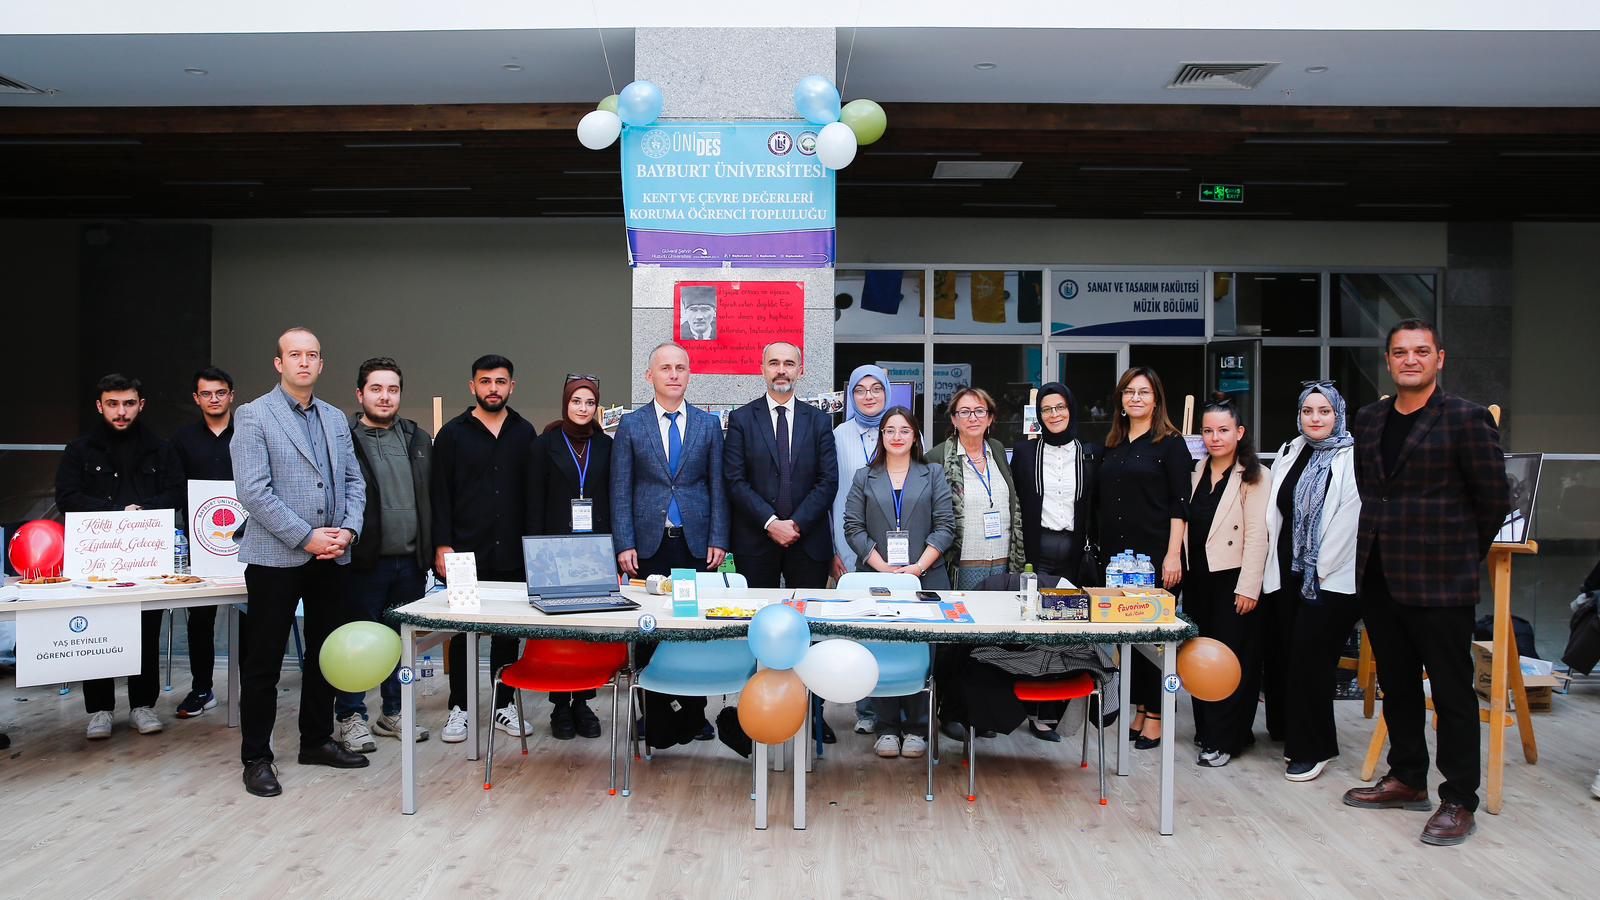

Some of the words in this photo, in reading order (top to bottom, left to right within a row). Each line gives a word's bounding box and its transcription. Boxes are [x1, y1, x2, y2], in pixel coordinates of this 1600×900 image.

[636, 164, 710, 178] BAYBURT
[643, 192, 678, 204] KENT
[680, 192, 696, 204] VE
[698, 192, 739, 207] ÇEVRE
[742, 190, 814, 204] DEĞERLERİ
[629, 208, 685, 220] KORUMA
[687, 206, 747, 220] ÖĞRENCİ
[749, 207, 828, 220] TOPLULUĞU
[1087, 282, 1112, 293] SANAT
[1114, 282, 1124, 293] VE
[1125, 282, 1159, 293] TASARIM
[1160, 280, 1199, 293] FAKÜLTESİ
[1133, 298, 1161, 313] MÜZİK
[1163, 299, 1199, 313] BÖLÜMÜ
[77, 518, 112, 535] Köklü
[75, 538, 126, 554] Aydınlık
[124, 537, 169, 552] Geleceğe
[81, 558, 107, 574] Yaş
[111, 557, 159, 573] Beyinlerle
[70, 636, 108, 646] BEYİNLER
[36, 650, 74, 661] ÖĞRENCİ
[76, 646, 124, 657] TOPLULUĞU
